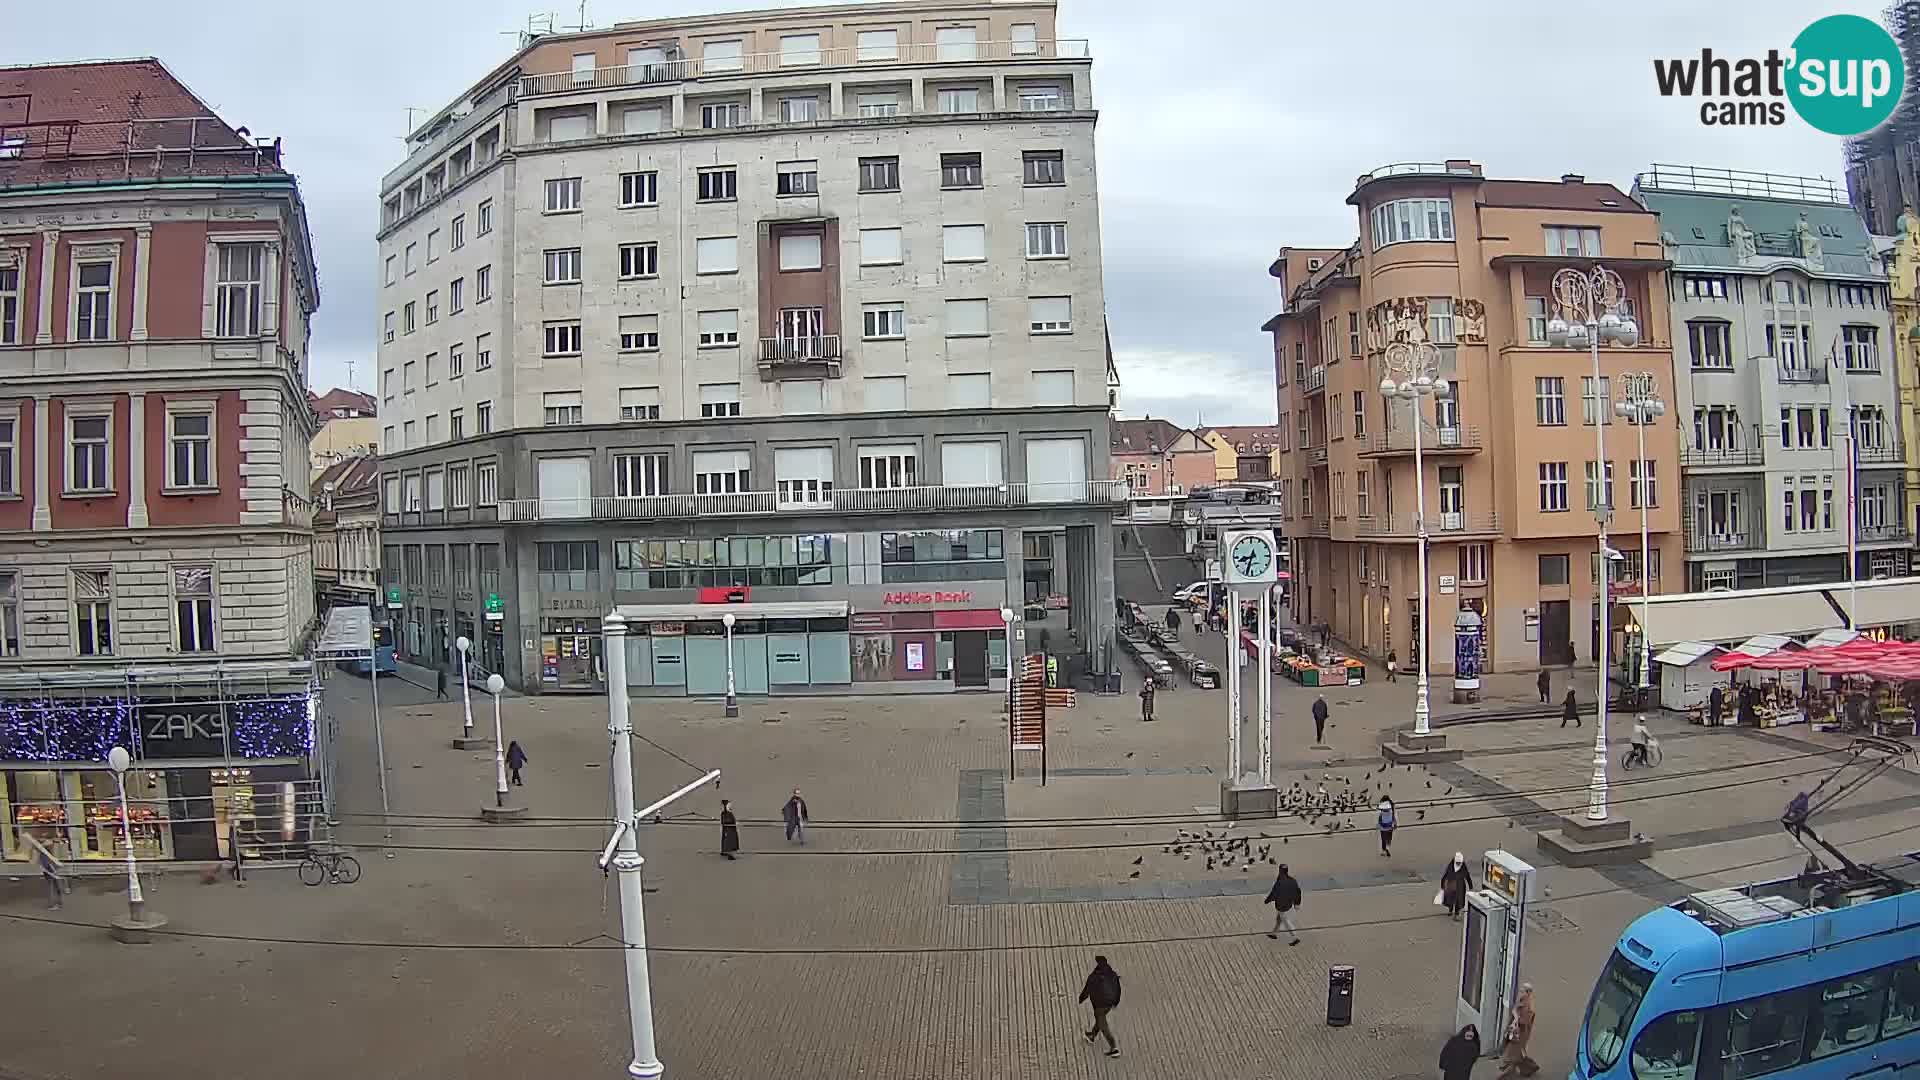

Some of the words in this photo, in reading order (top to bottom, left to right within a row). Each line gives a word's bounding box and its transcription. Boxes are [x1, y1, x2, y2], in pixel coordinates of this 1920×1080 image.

[884, 592, 932, 604] Addiko
[935, 590, 969, 602] Bank
[145, 714, 224, 738] ZAKS
